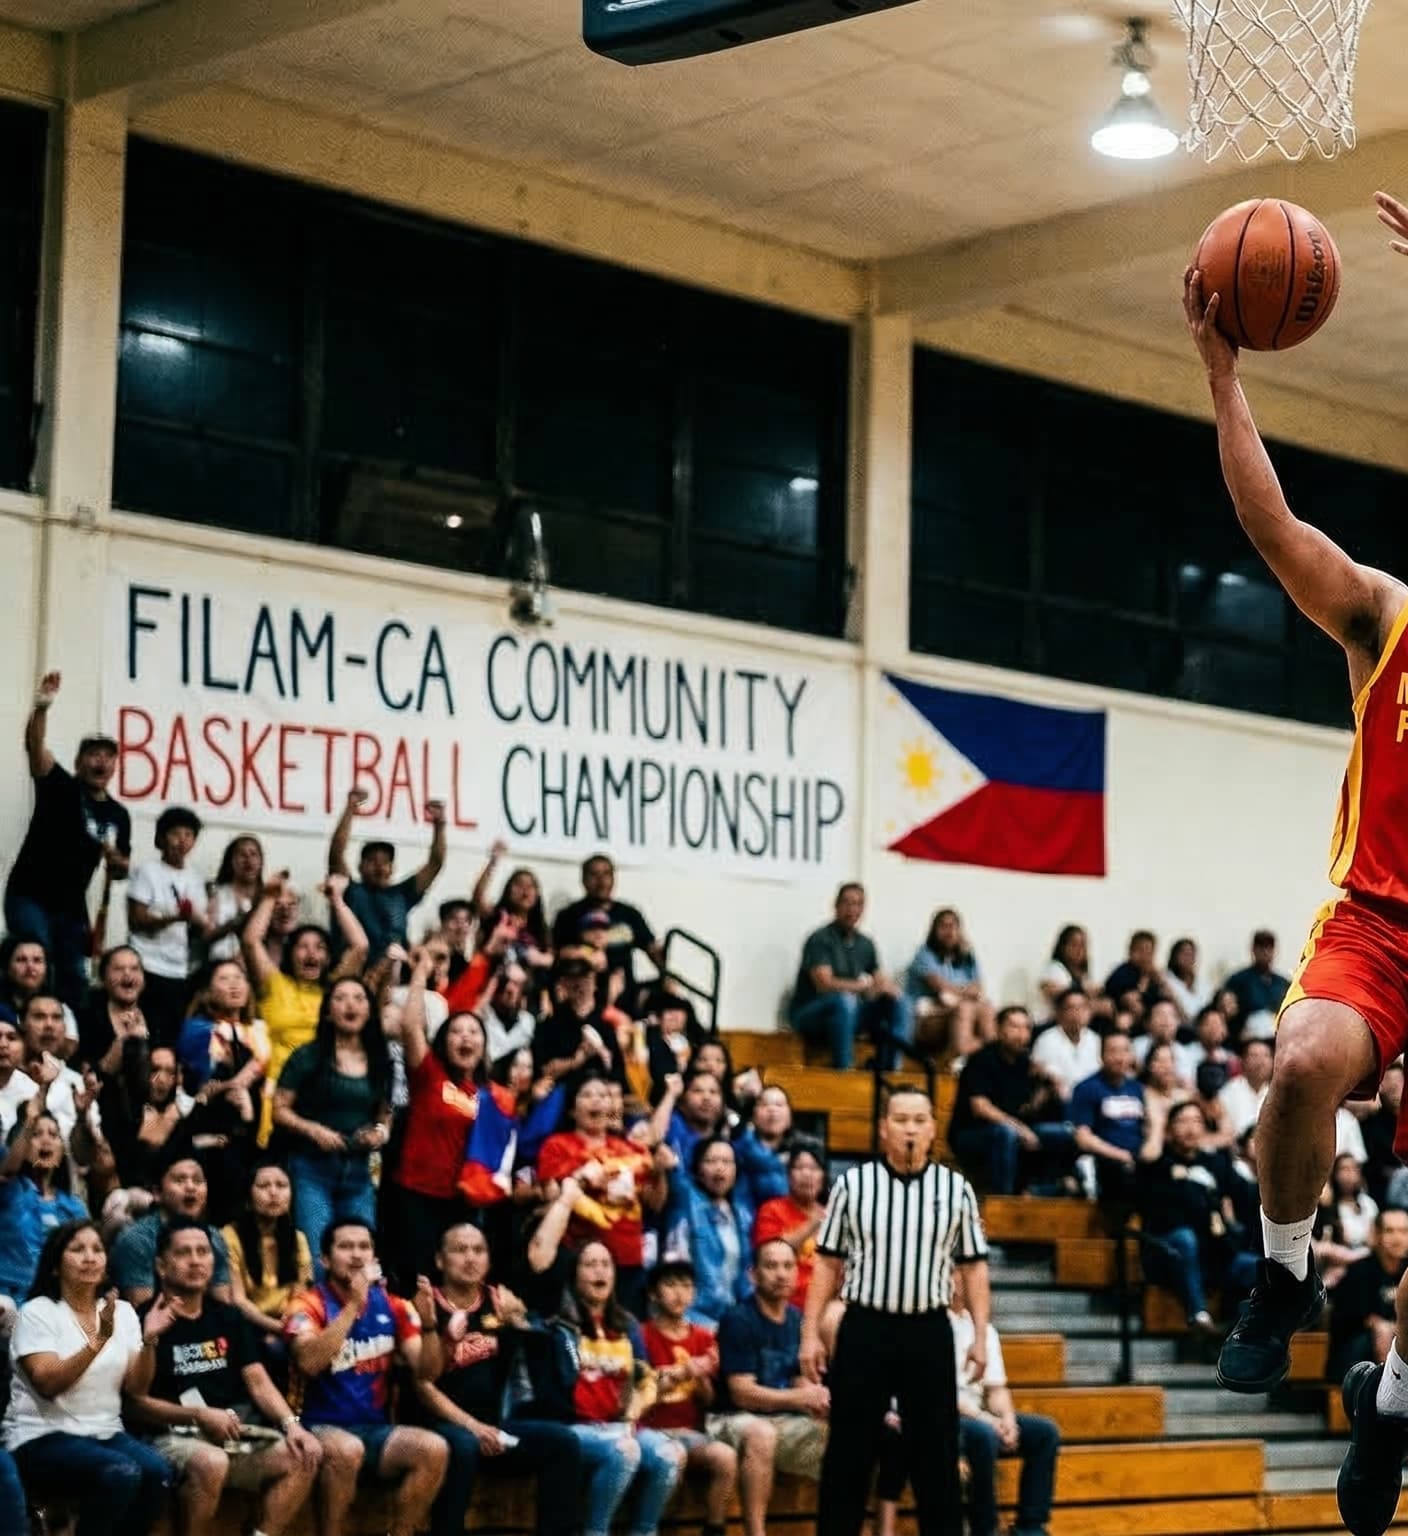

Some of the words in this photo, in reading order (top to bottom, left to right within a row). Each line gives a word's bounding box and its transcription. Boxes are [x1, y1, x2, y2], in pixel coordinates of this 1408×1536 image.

[1295, 231, 1326, 323] Wilson
[127, 584, 455, 717] FILAM-CA
[487, 635, 808, 758] COMMUNITY
[116, 706, 478, 828] BASKETBALL
[501, 744, 845, 864] CHAMPIONSHIP
